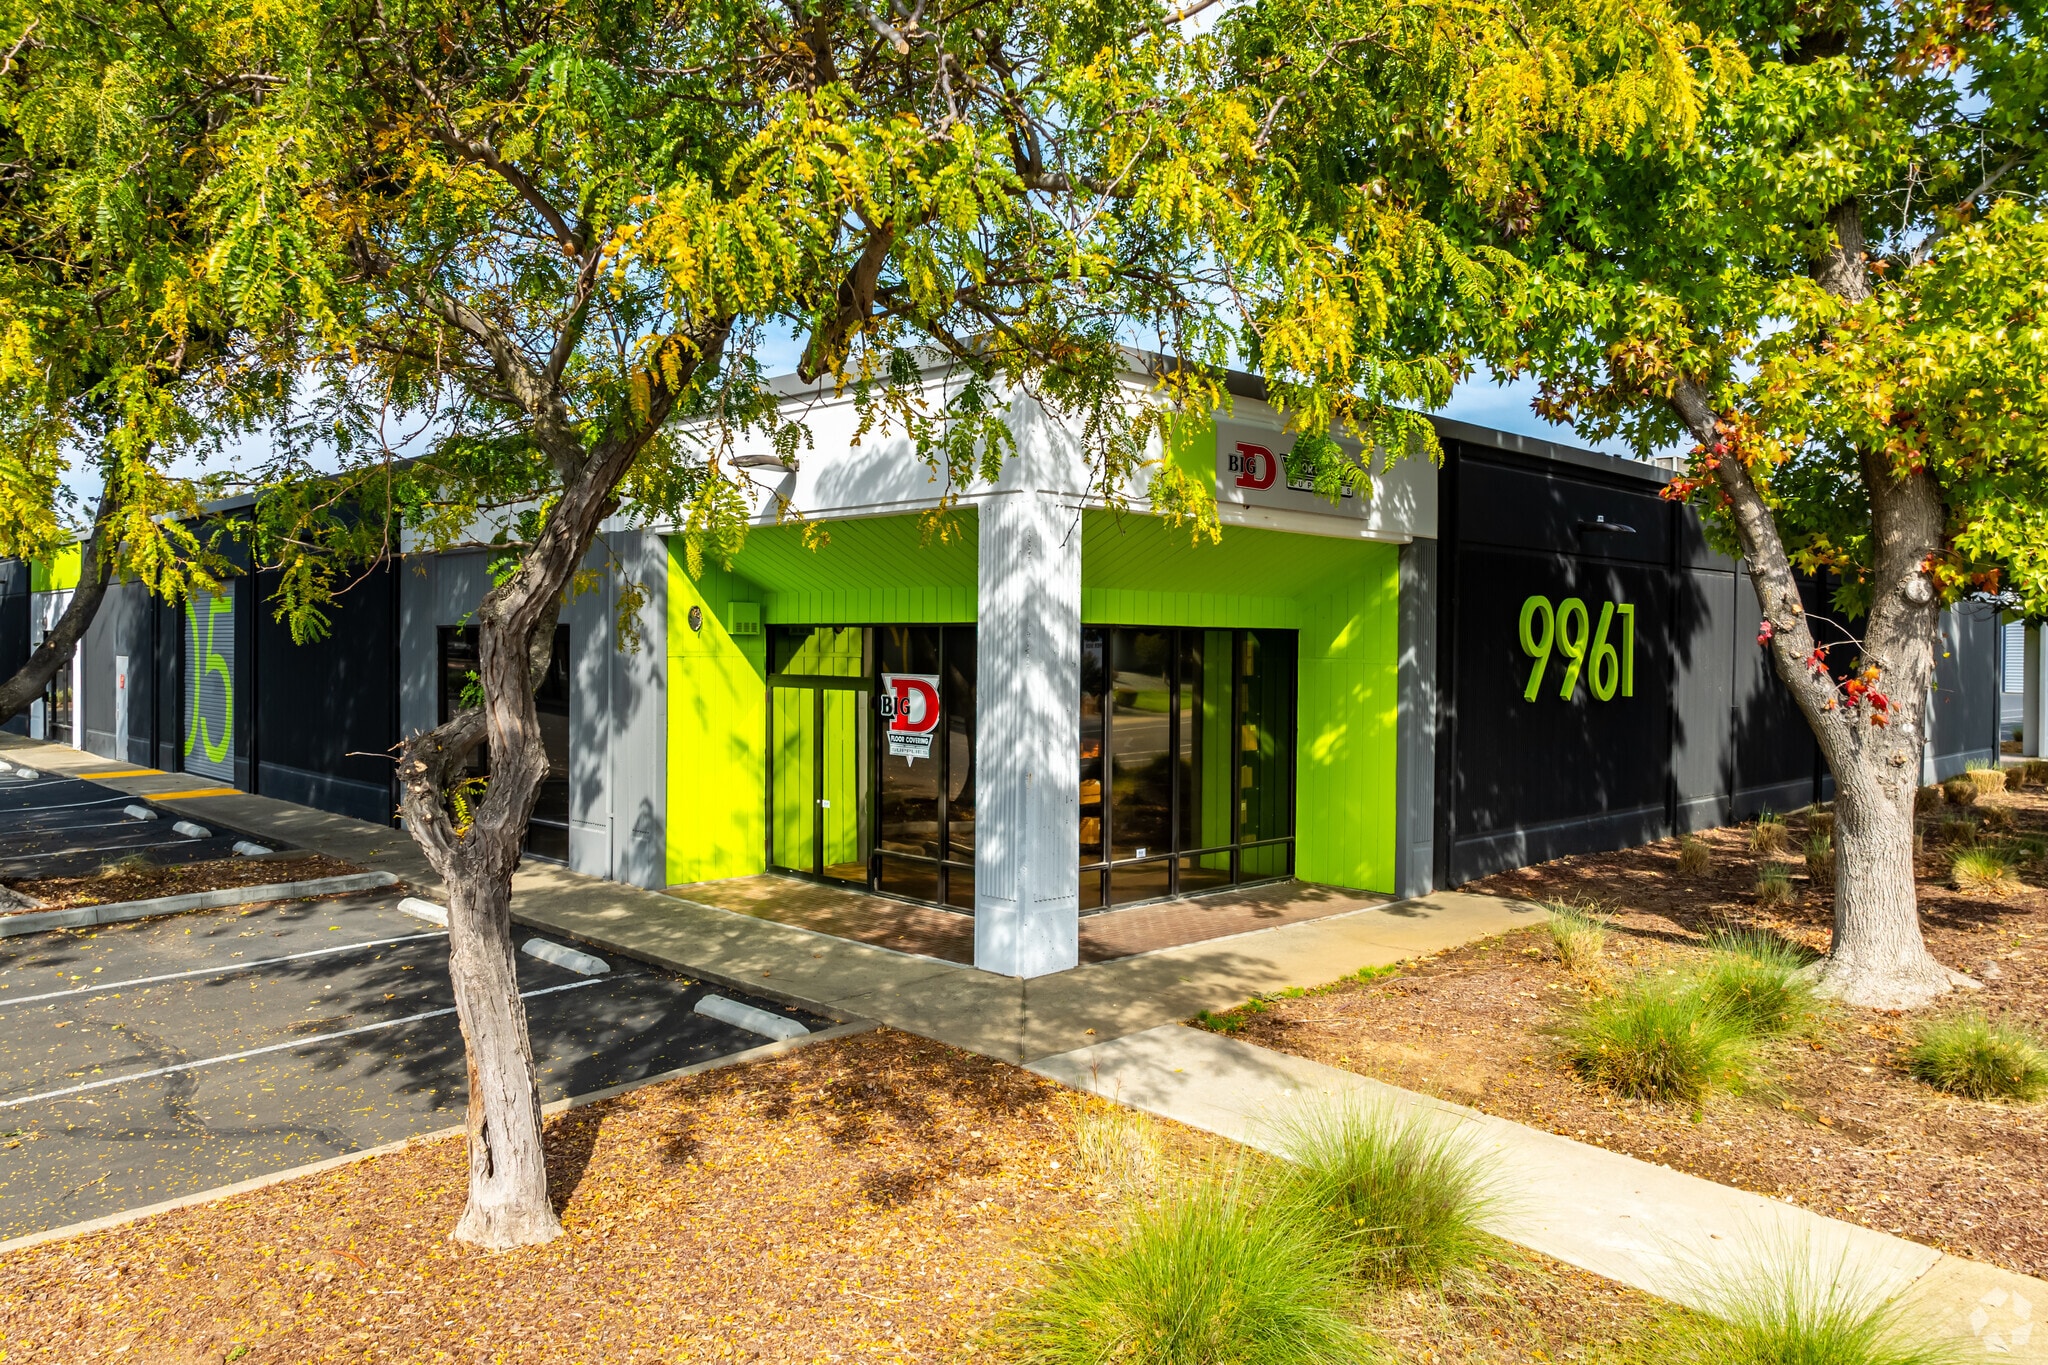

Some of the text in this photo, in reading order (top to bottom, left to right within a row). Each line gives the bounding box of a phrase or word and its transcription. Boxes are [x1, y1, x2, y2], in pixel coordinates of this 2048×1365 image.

[1228, 454, 1256, 475] BIG
[1235, 441, 1277, 491] D
[1519, 595, 1634, 703] 9961
[881, 679, 939, 732] BIG D
[891, 735, 905, 743] FLOOR
